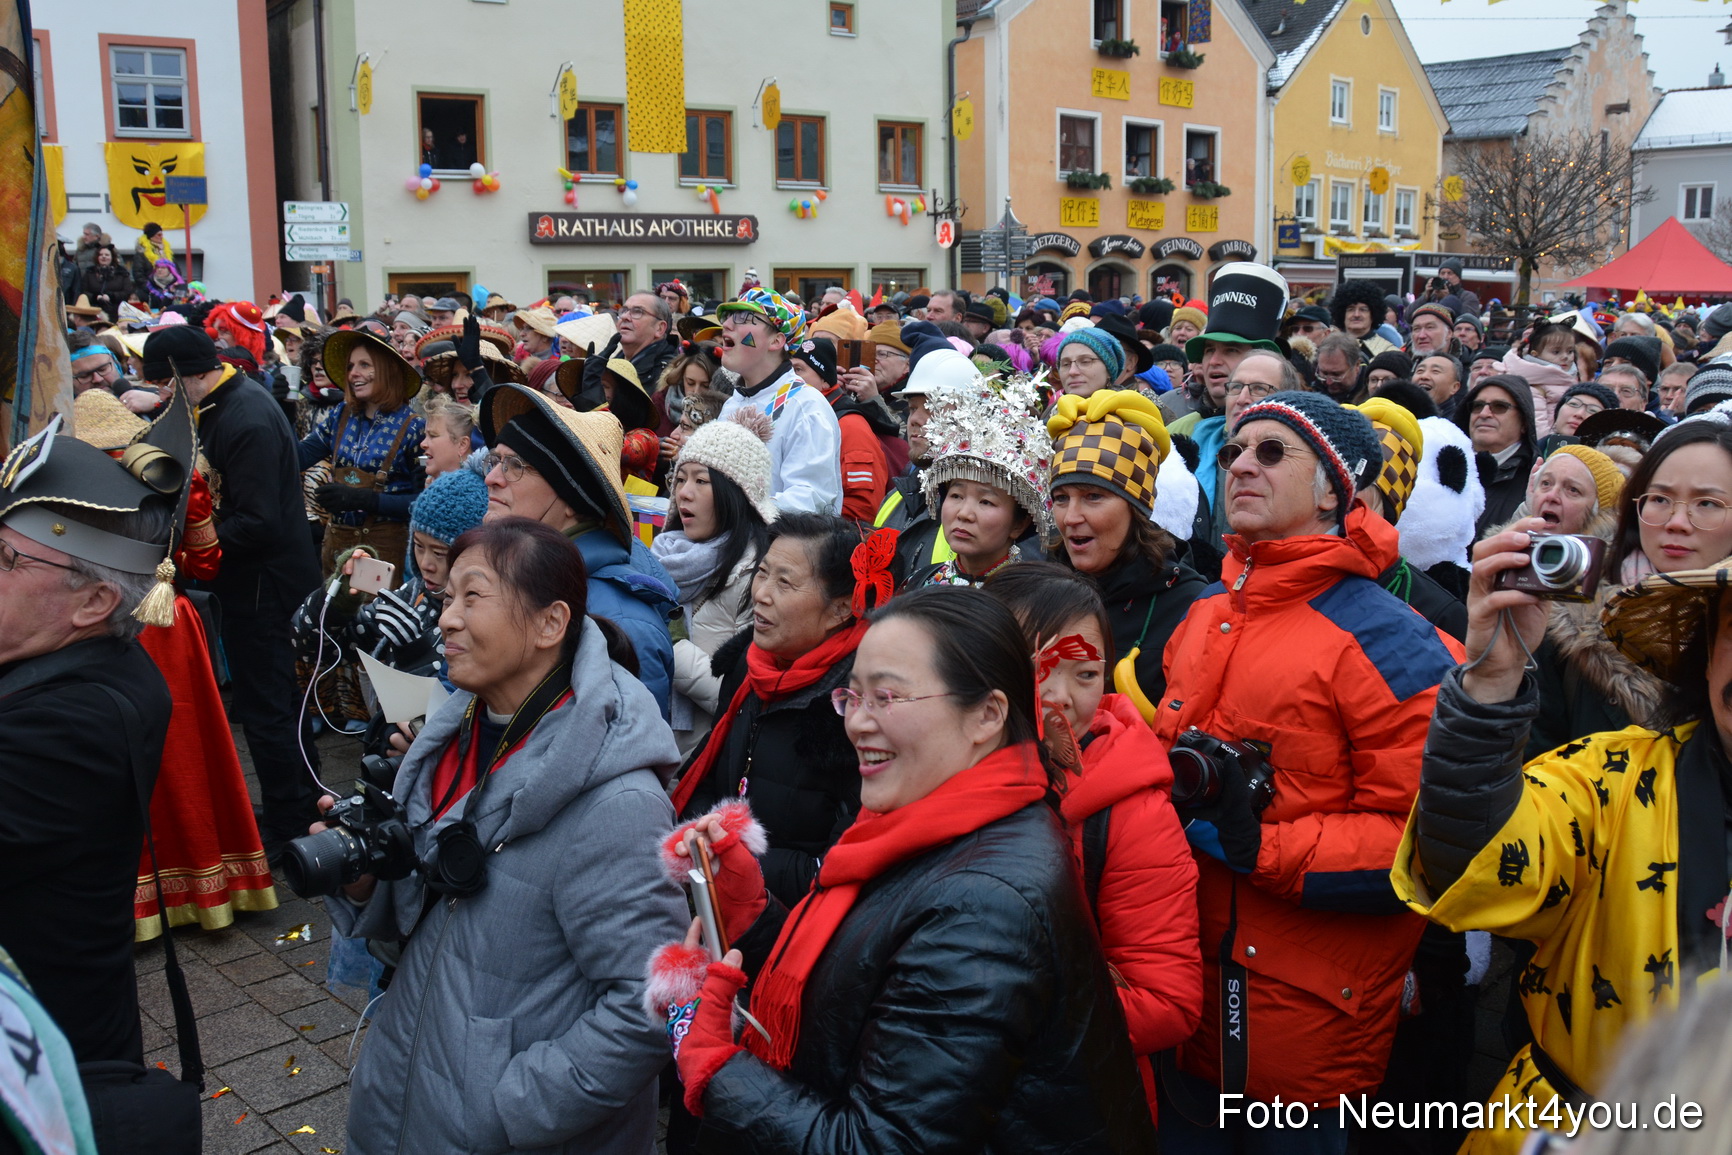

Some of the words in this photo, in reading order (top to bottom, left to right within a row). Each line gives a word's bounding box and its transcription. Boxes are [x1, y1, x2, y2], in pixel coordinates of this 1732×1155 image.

[557, 217, 645, 238] RATHAUS
[647, 218, 734, 238] APOTHEKE
[1160, 238, 1203, 258] FEINKOST
[1221, 240, 1253, 255] IMBISS
[1339, 256, 1377, 268] IMBISS
[1212, 291, 1258, 308] GUINNESS
[1220, 743, 1241, 758] SONY
[1227, 978, 1241, 1042] SONY
